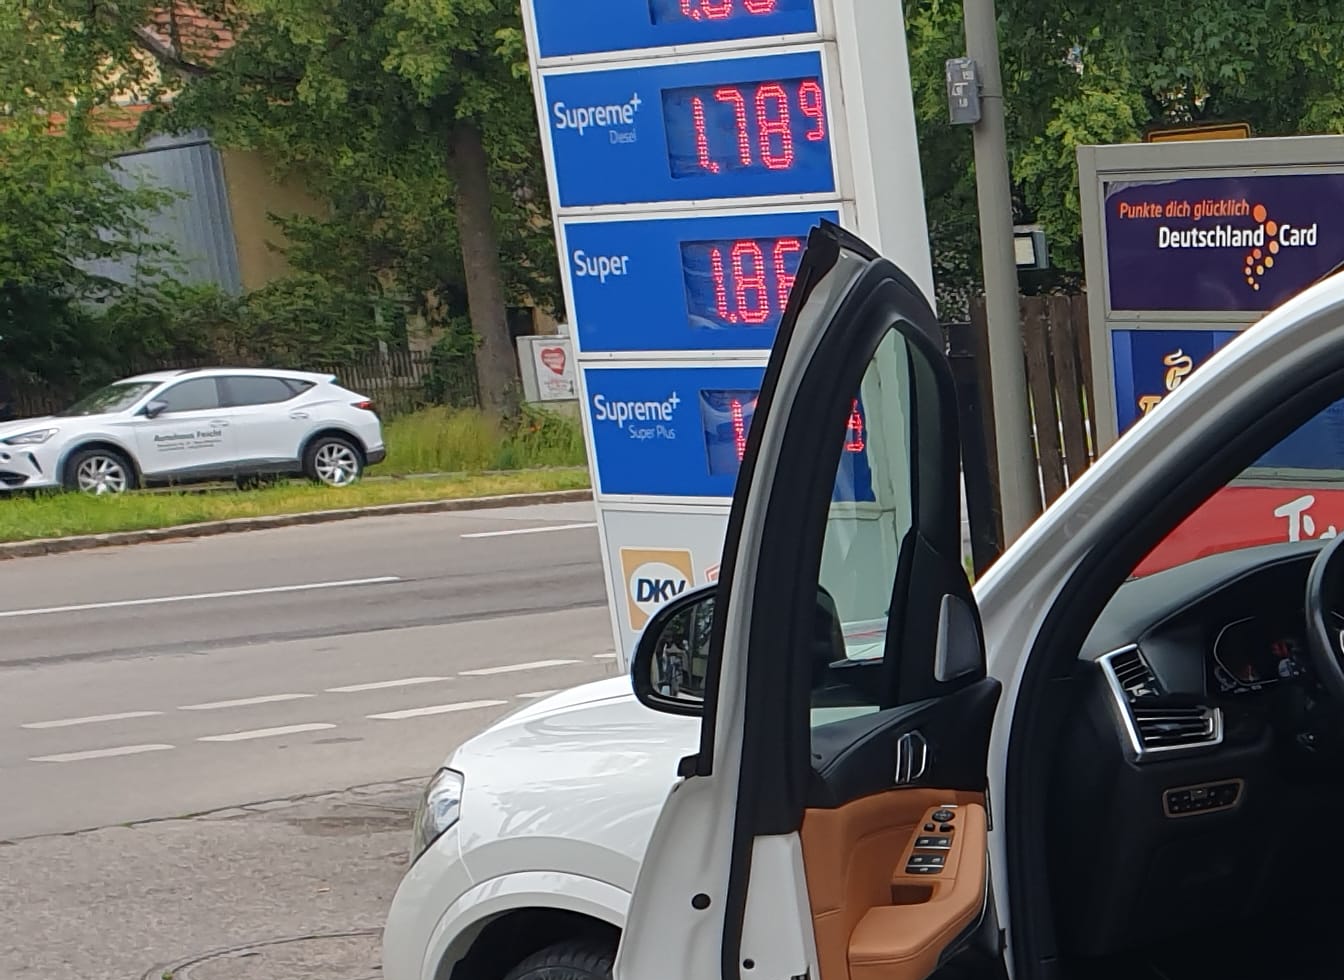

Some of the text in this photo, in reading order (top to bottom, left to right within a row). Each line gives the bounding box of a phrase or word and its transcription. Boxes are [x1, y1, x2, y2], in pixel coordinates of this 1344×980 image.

[608, 128, 637, 144] Diesel
[1119, 199, 1250, 221] Punkte dich glücklich
[1158, 223, 1318, 249] Deutschland Card
[573, 250, 629, 284] Super
[628, 424, 676, 441] Super Plus
[636, 578, 687, 604] DKV
